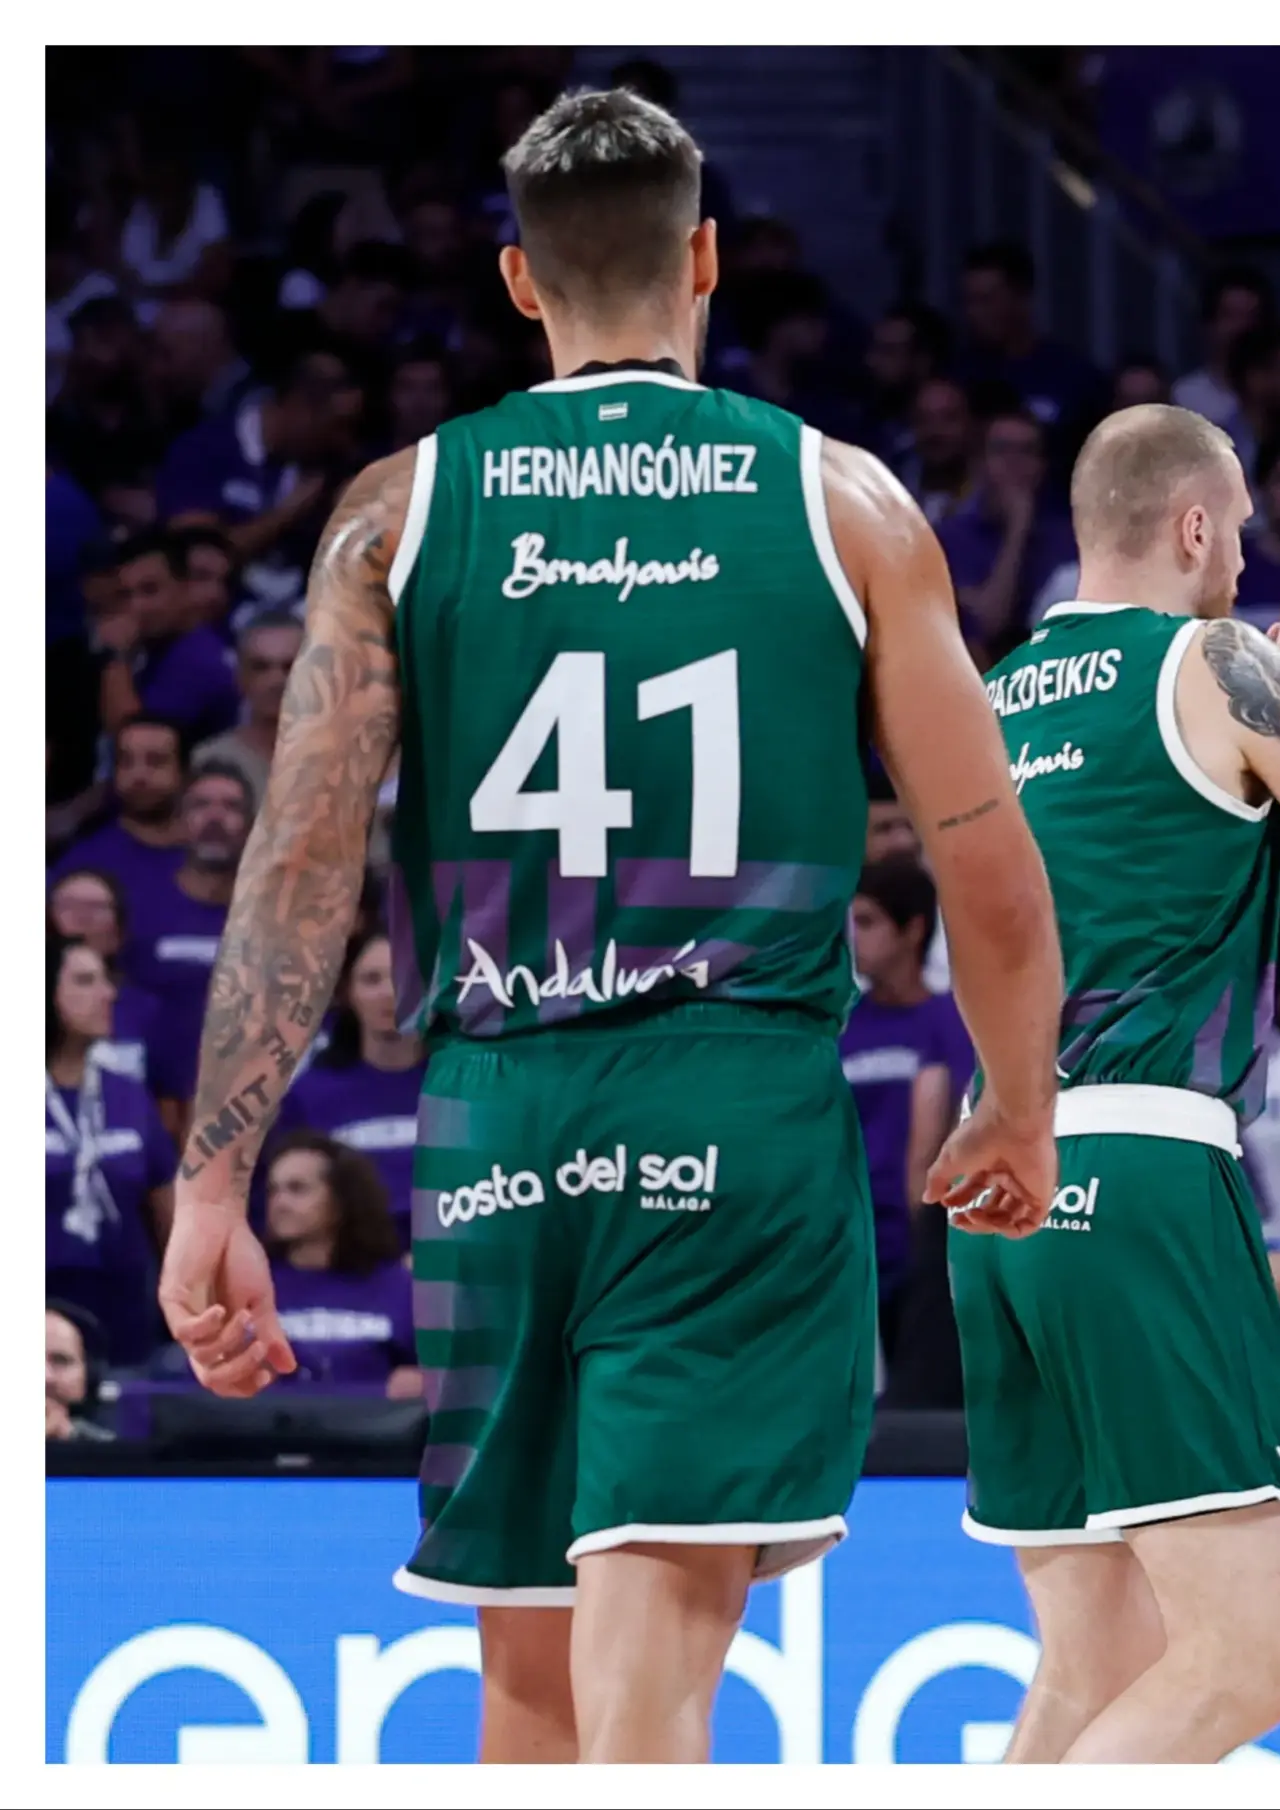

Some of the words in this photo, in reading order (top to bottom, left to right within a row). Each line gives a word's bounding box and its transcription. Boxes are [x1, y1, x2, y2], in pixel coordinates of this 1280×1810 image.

[483, 433, 758, 500] HERNANGÓMEZ
[469, 647, 741, 878] 41
[437, 1164, 545, 1227] costa
[555, 1144, 627, 1196] del
[638, 1145, 718, 1193] sol
[640, 1195, 712, 1212] MÁLAGA
